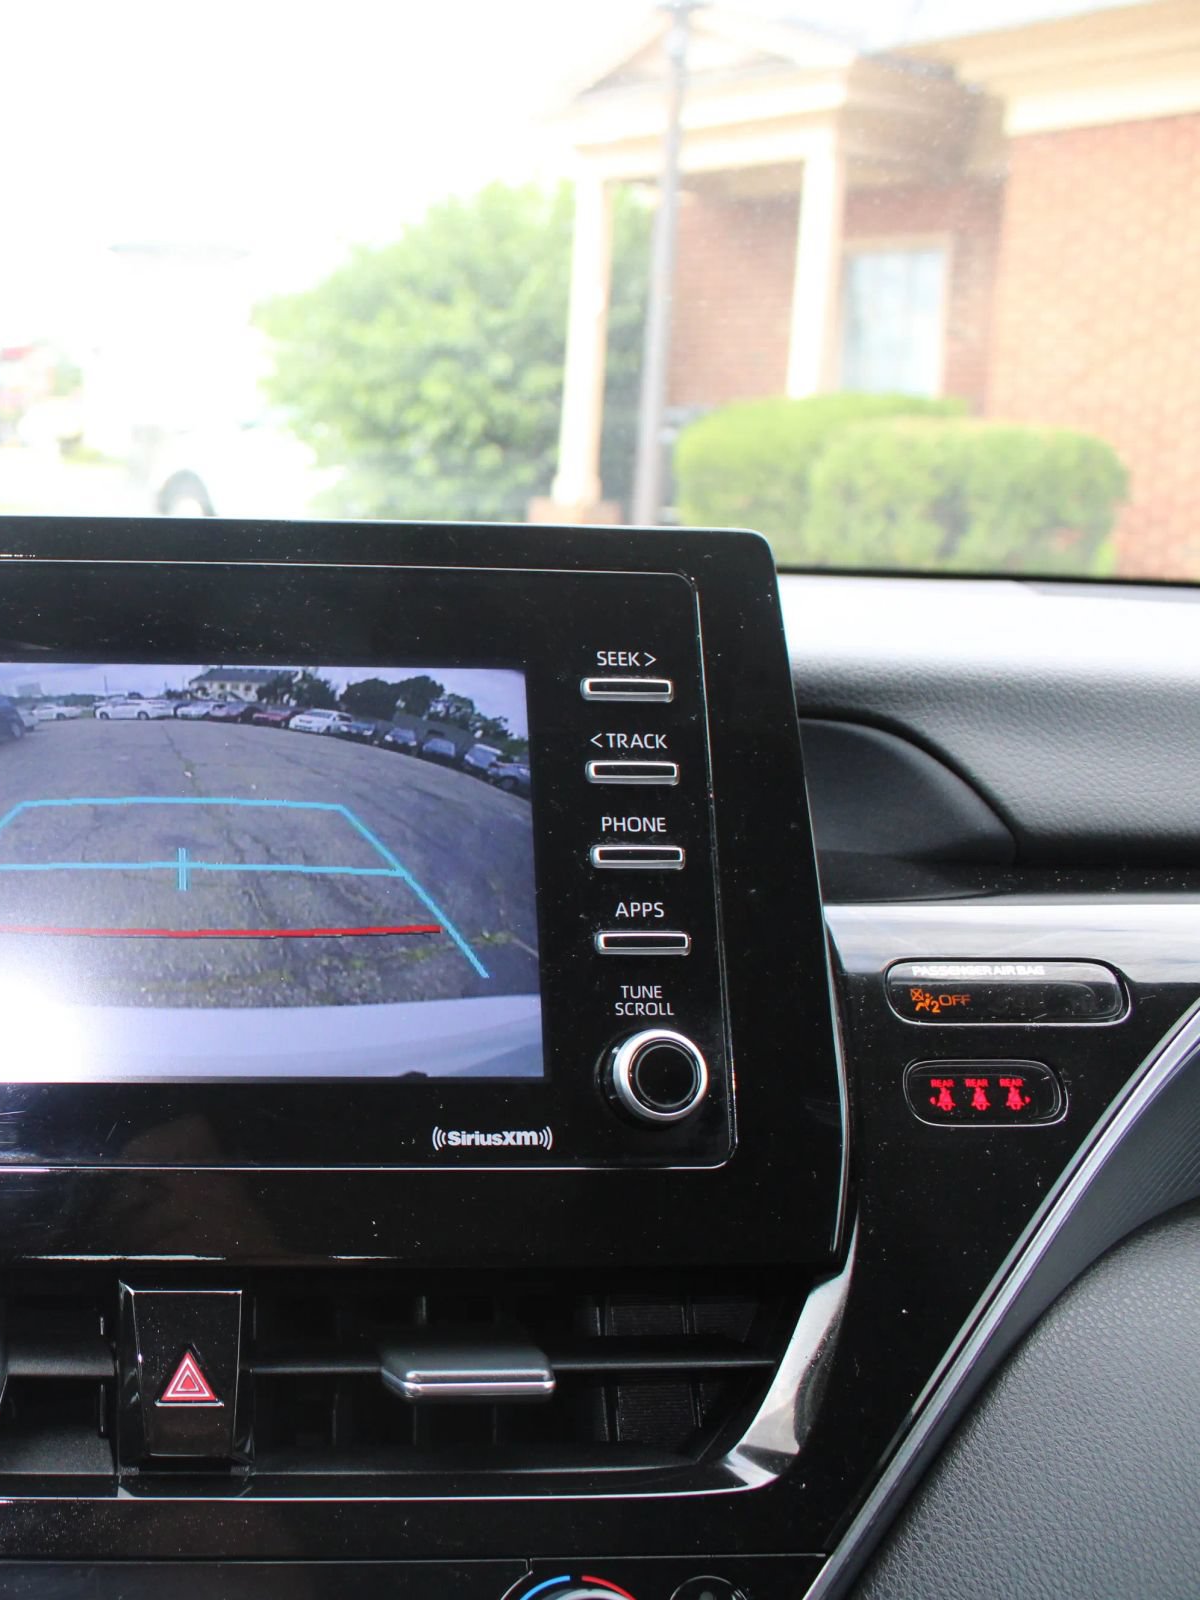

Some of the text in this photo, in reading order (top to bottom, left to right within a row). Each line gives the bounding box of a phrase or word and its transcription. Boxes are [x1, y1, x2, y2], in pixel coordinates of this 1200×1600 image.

[601, 817, 667, 832] PHONE
[615, 902, 665, 918] APPS
[911, 966, 1046, 976] PASSENGER AIR BAG
[621, 985, 663, 999] TUNE
[939, 994, 971, 1006] OFF
[615, 1002, 675, 1017] SCROLL
[930, 1078, 954, 1088] REAR
[964, 1078, 988, 1088] REAR
[999, 1078, 1023, 1088] REAR
